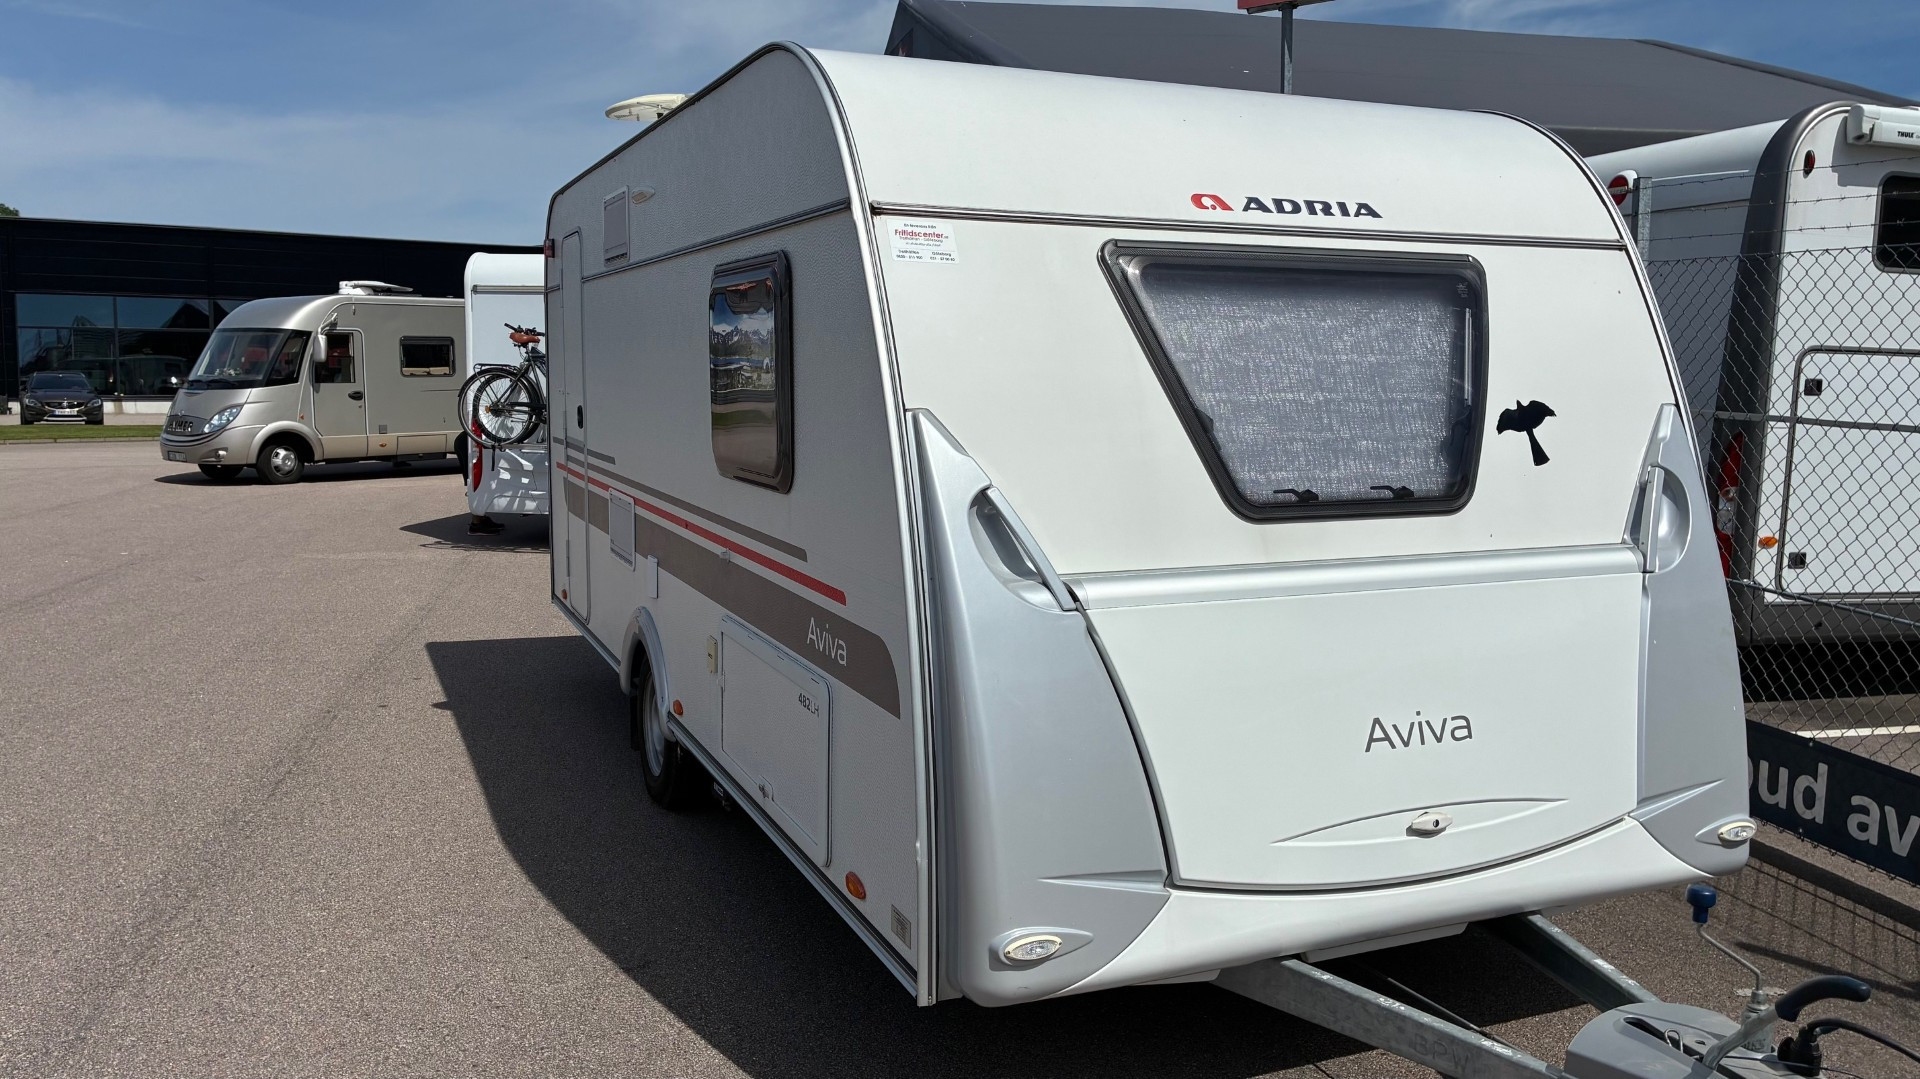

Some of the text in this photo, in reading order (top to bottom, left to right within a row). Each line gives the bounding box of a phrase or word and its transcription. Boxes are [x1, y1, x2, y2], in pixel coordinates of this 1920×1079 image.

[1897, 130, 1915, 139] THULE
[1242, 196, 1384, 219] ADRIA
[806, 616, 847, 667] Aviva
[798, 692, 820, 719] 482LH
[1364, 710, 1473, 753] Aviva
[1846, 794, 1920, 858] av
